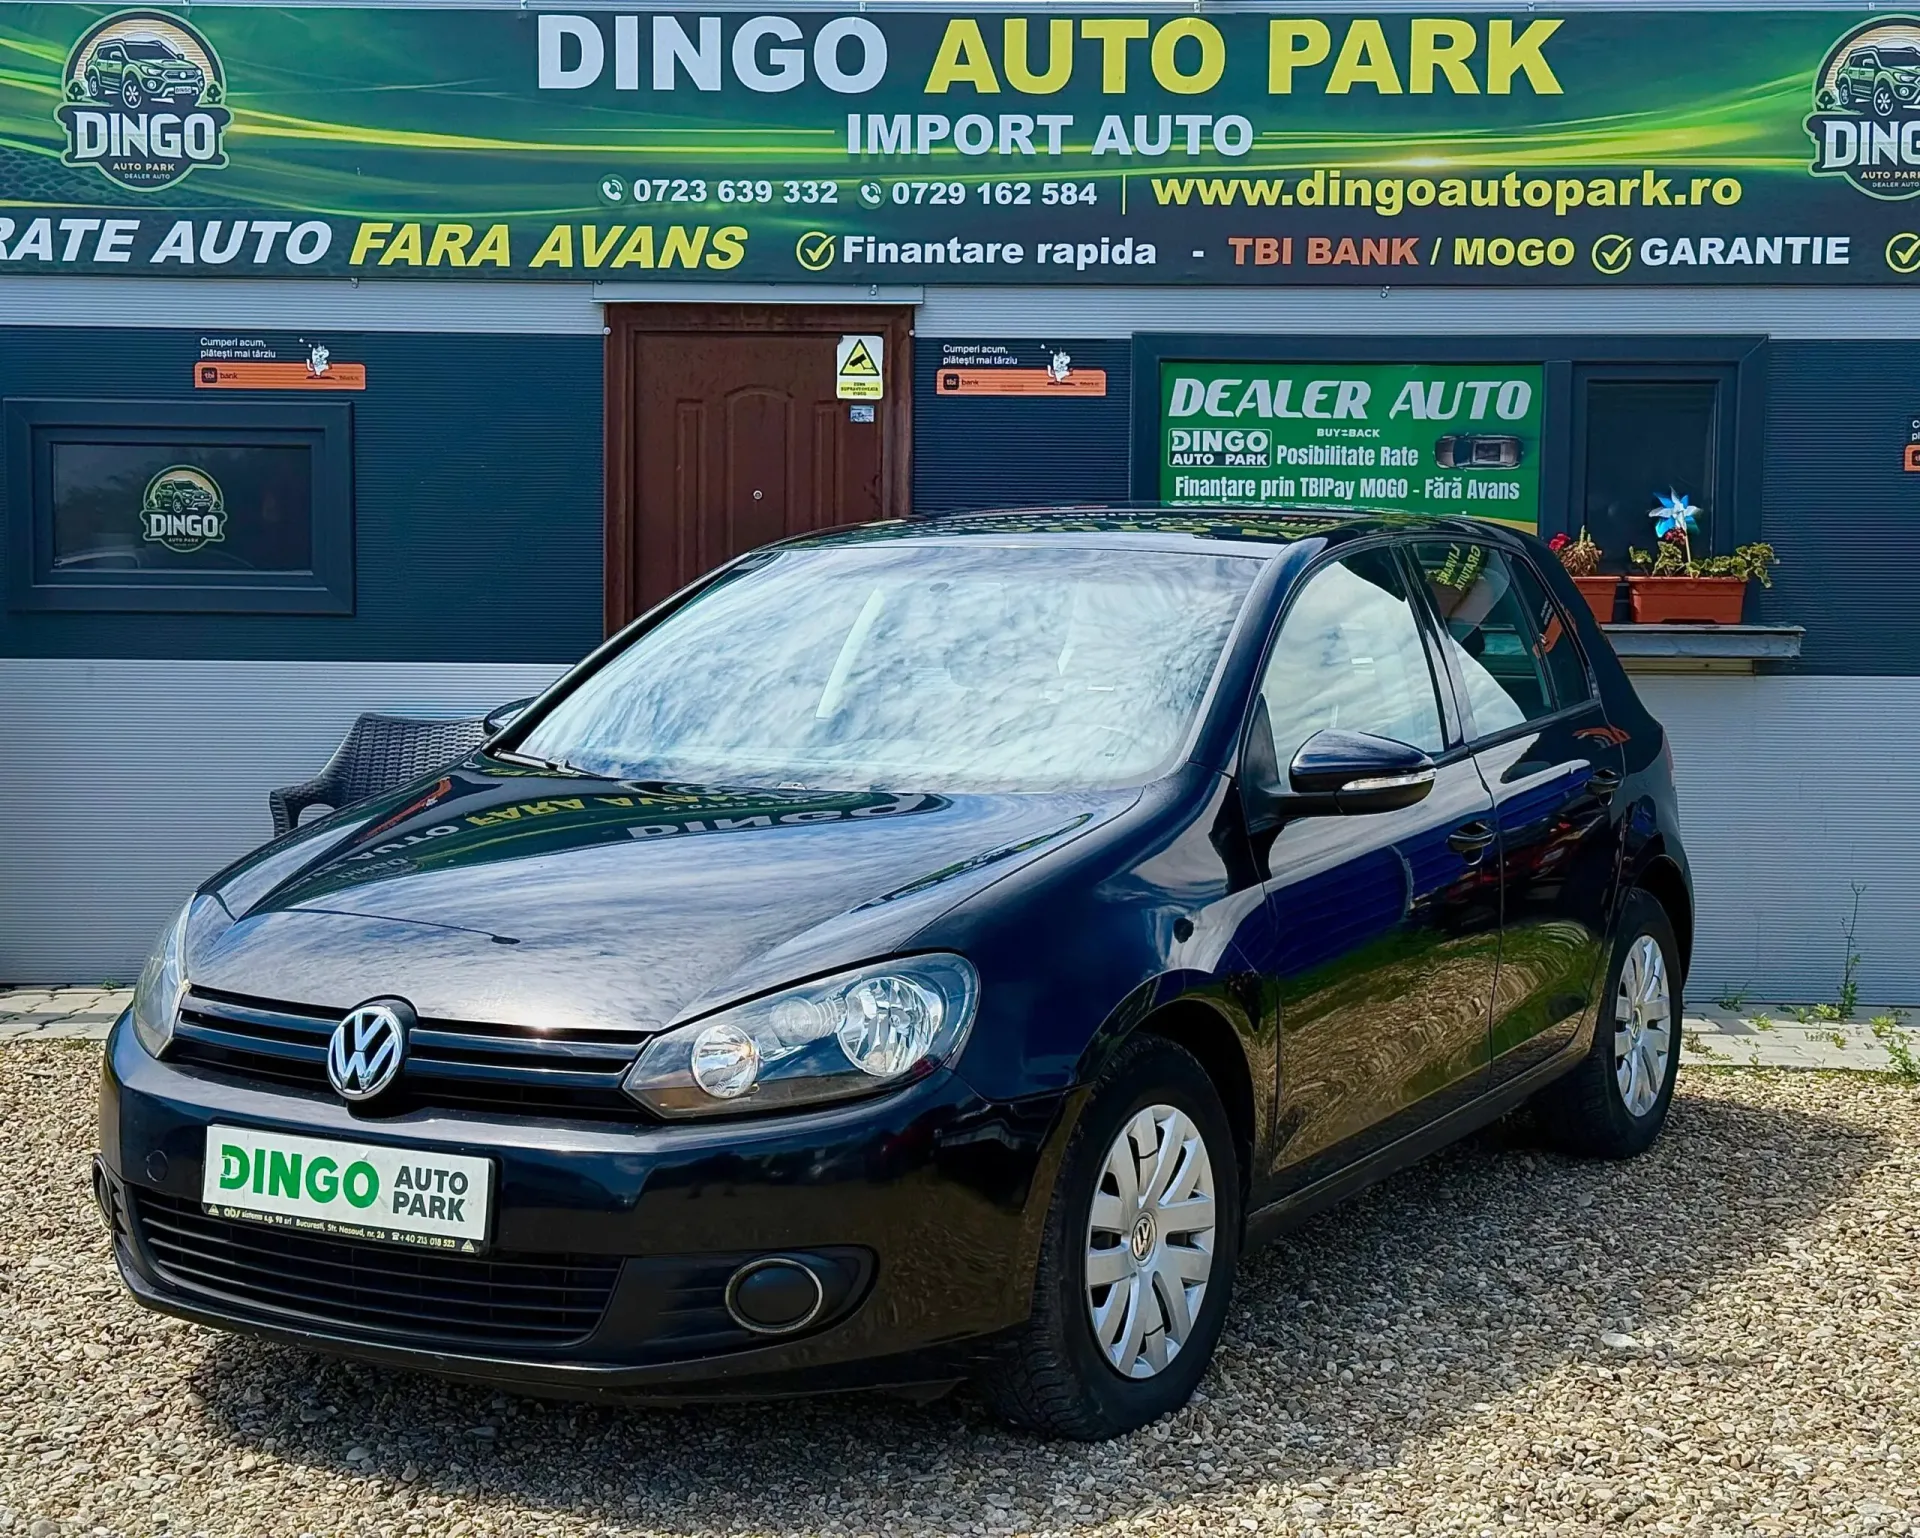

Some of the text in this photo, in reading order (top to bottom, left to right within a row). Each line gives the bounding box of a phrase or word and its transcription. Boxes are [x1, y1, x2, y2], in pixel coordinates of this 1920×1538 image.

[538, 14, 1564, 95] DINGO AUTO PARK
[73, 111, 215, 160] DINGO
[847, 113, 1254, 157] IMPORT AUTO
[113, 163, 175, 171] AUTO PARK
[1861, 171, 1891, 179] AUTO
[633, 179, 838, 204] 0723 639 332
[892, 182, 1097, 206] 0729 162 584
[1151, 170, 1742, 217] www.dingoautopark.ro
[150, 219, 332, 266] AUTO
[349, 222, 510, 268] FARA
[529, 224, 748, 271] AVANS
[843, 236, 1024, 265] Finantare
[1036, 236, 1156, 271] rapida
[1228, 237, 1292, 266] TBI
[1307, 237, 1419, 267] BANK
[1455, 237, 1574, 267] MOGO
[1640, 236, 1850, 266] GARANTIE
[200, 337, 267, 349] Cumperi acum,
[234, 349, 250, 358] mai
[943, 344, 1008, 356] Cumperi acum,
[976, 356, 992, 364] mai
[219, 372, 238, 380] bank
[961, 378, 979, 386] bank
[1168, 378, 1532, 420] DEALER AUTO
[1171, 430, 1268, 453] DINGO
[1172, 453, 1268, 466] AUTO PARK
[1277, 444, 1419, 467] Posibilitate Rate
[1175, 475, 1256, 501] Finanțare
[1260, 476, 1295, 500] prin
[1300, 477, 1355, 500] TBIPay
[1360, 478, 1408, 499] MOGO
[1425, 476, 1462, 499] Fără
[1467, 479, 1520, 500] Avans
[149, 514, 218, 537] DINGO
[219, 1143, 380, 1209] DINGO
[394, 1165, 469, 1195] AUTO
[392, 1191, 465, 1222] PARK
[376, 1230, 385, 1240] 26
